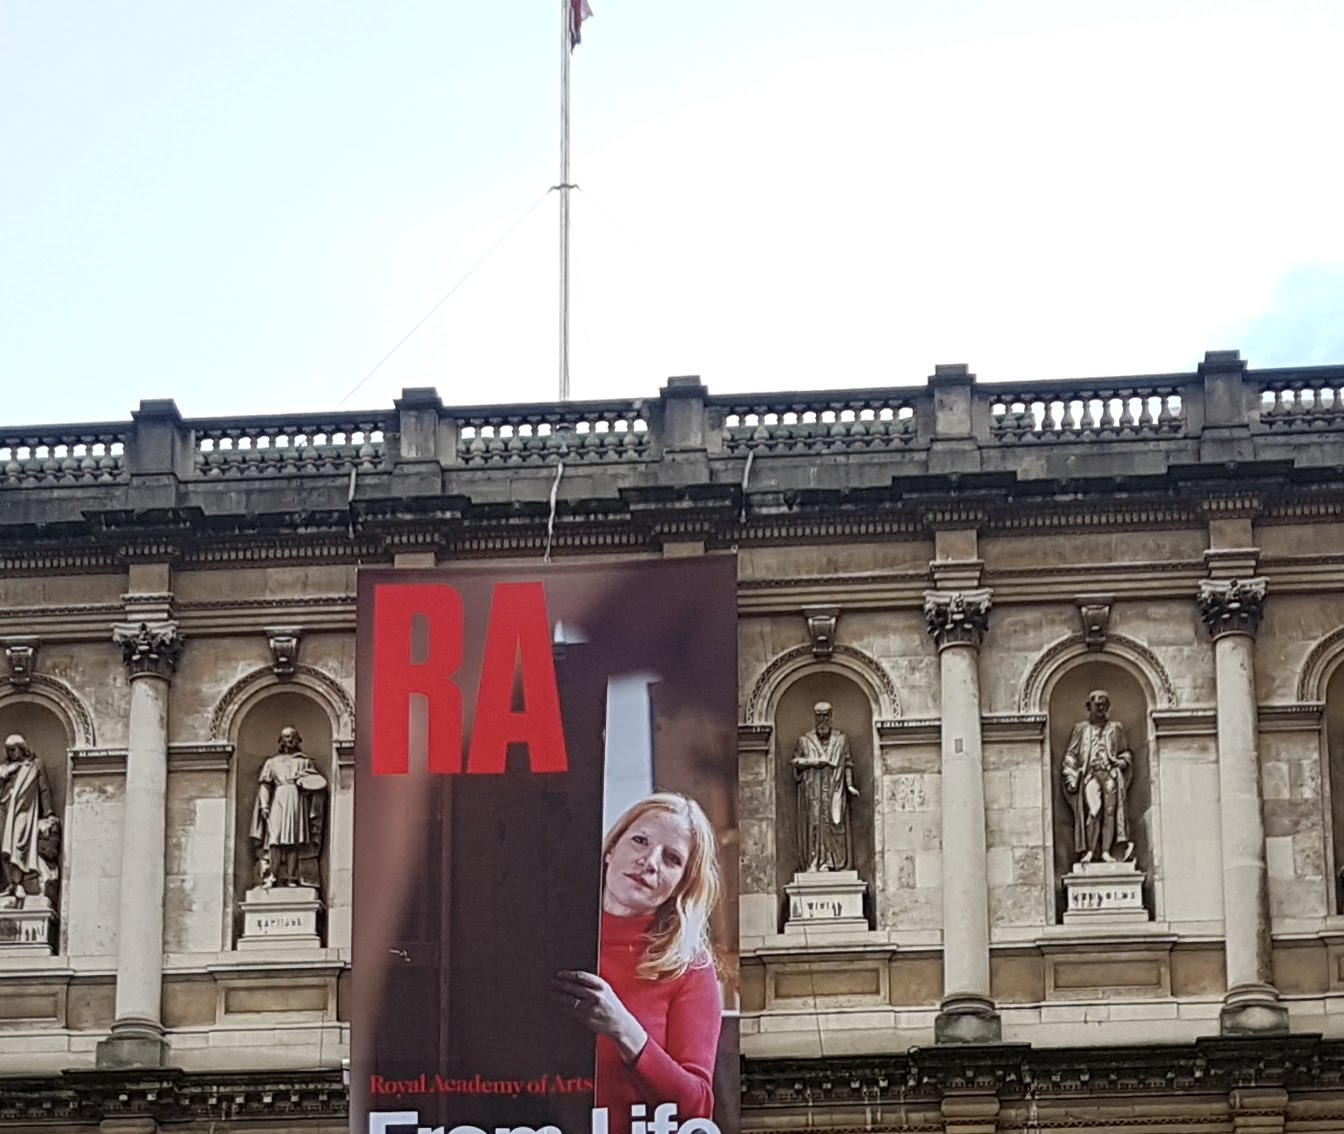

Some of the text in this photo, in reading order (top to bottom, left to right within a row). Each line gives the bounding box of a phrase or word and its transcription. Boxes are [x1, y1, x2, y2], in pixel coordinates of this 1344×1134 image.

[371, 581, 569, 776] RA
[368, 1073, 594, 1098] Royal Academy of Arts
